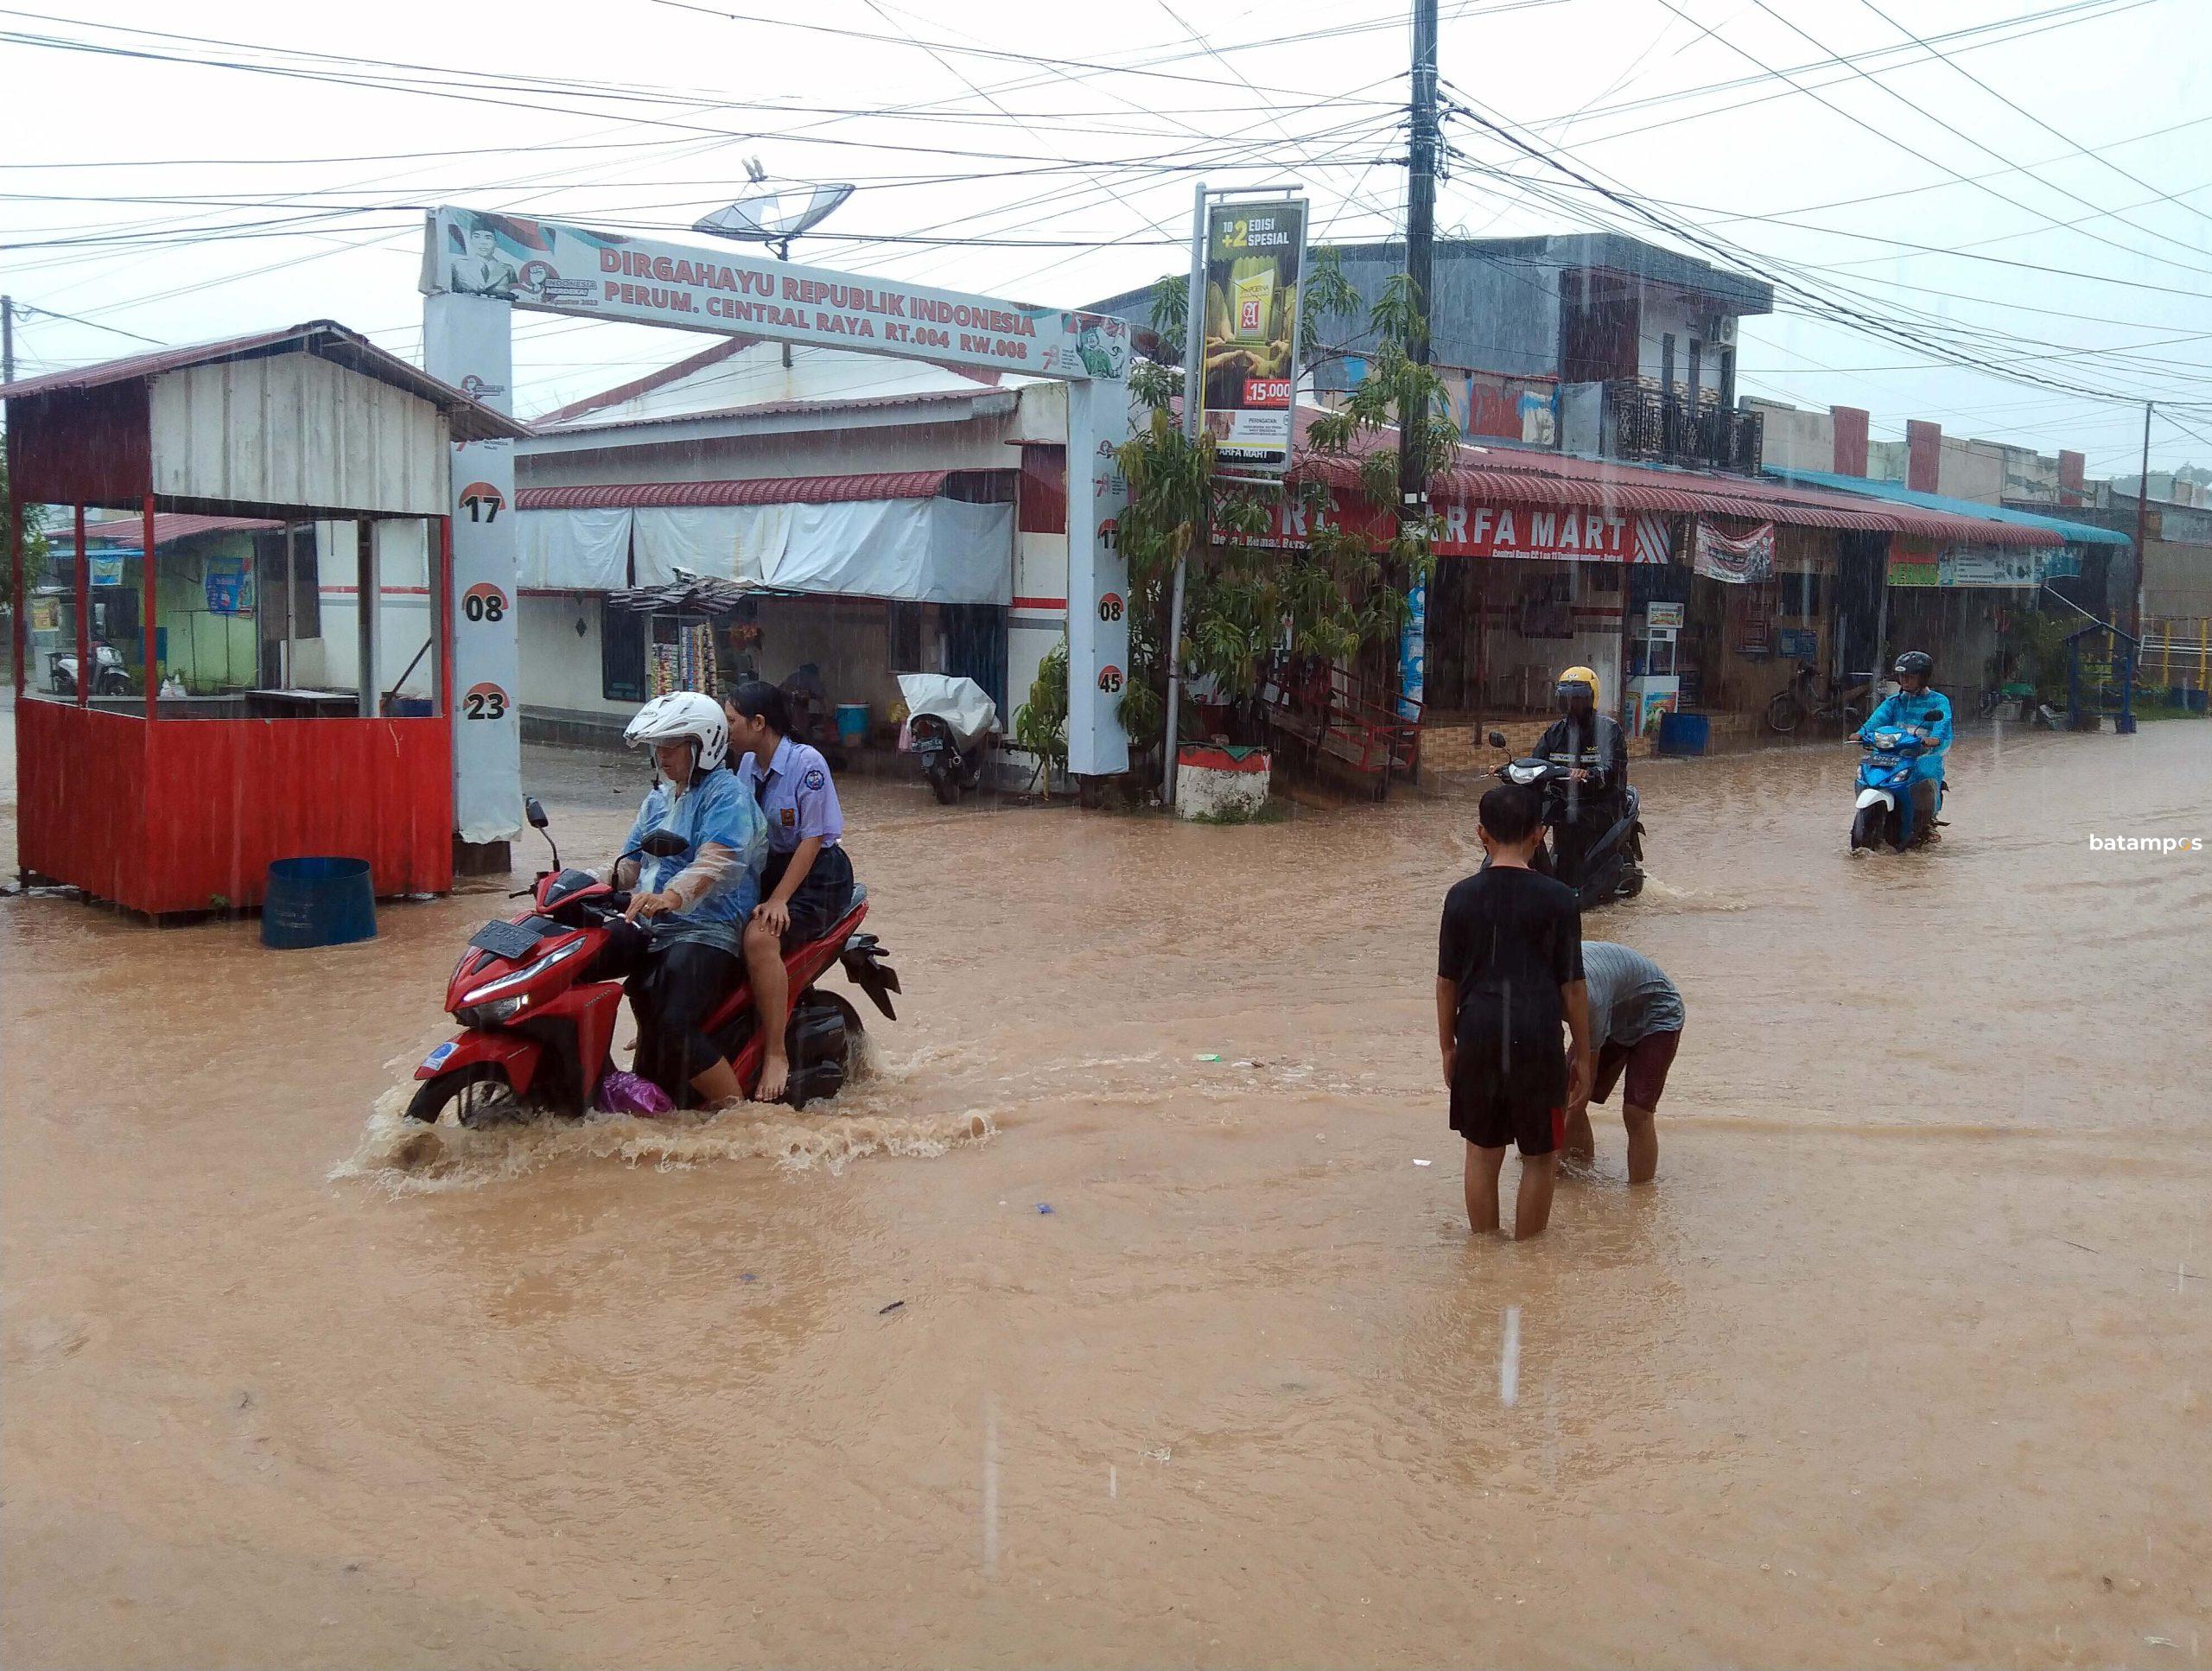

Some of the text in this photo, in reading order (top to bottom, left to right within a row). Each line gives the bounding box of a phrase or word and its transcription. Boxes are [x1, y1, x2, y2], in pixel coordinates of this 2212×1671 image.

[1249, 218, 1274, 232] EDISI
[1248, 232, 1289, 246] SPESIAL
[599, 247, 1036, 338] DIRGAHAYU REPUBLIK INDONESIA
[604, 281, 1027, 360] PERUM. CENTRAL RAYA RT.004 RW.008
[1250, 383, 1290, 401] 15.000
[1219, 448, 1268, 459] ARFA MART
[464, 495, 501, 524] 17
[1530, 511, 1626, 550] MART
[467, 594, 504, 623] 08
[1099, 600, 1121, 622] 08
[1099, 672, 1121, 694] 45
[467, 693, 505, 721] 23
